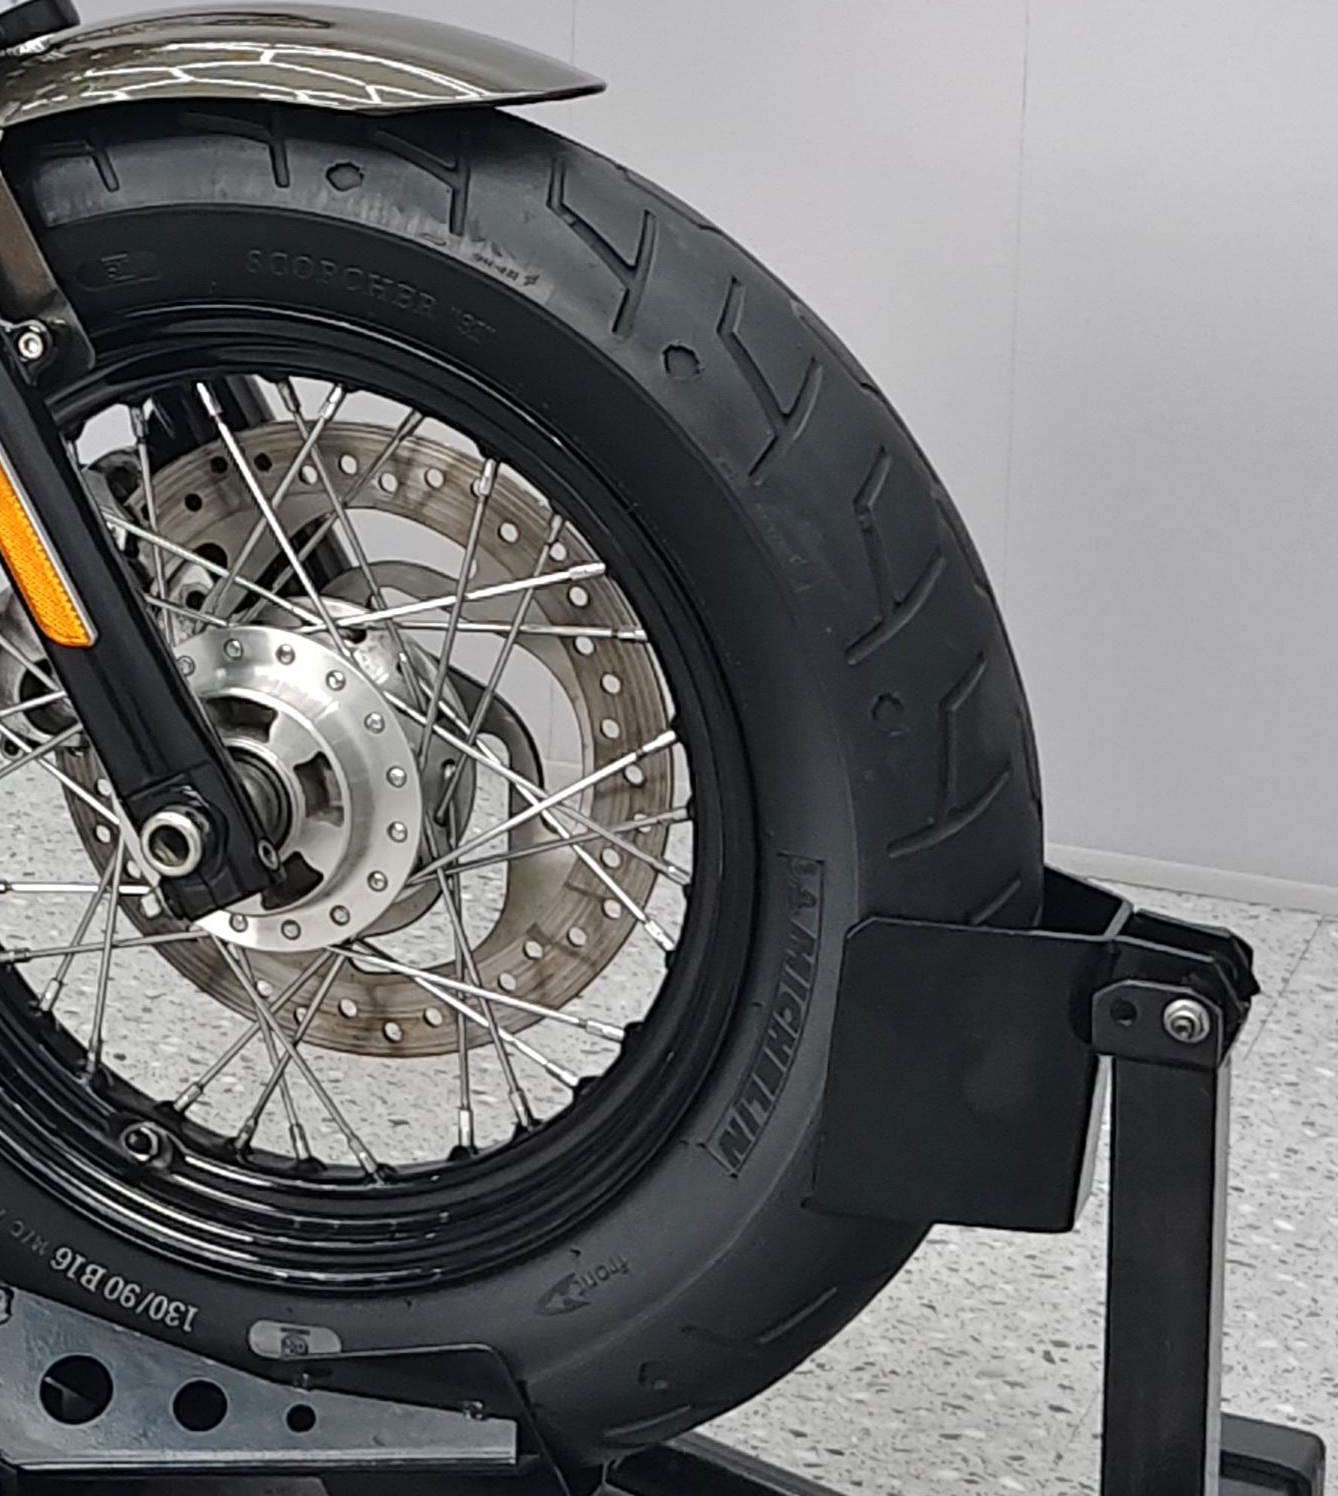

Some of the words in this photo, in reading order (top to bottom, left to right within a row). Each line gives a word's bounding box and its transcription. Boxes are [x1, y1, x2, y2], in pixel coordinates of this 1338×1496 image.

[244, 247, 442, 319] SCORCHER
[49, 1246, 108, 1294] B16
[103, 1275, 200, 1333] 130/90
